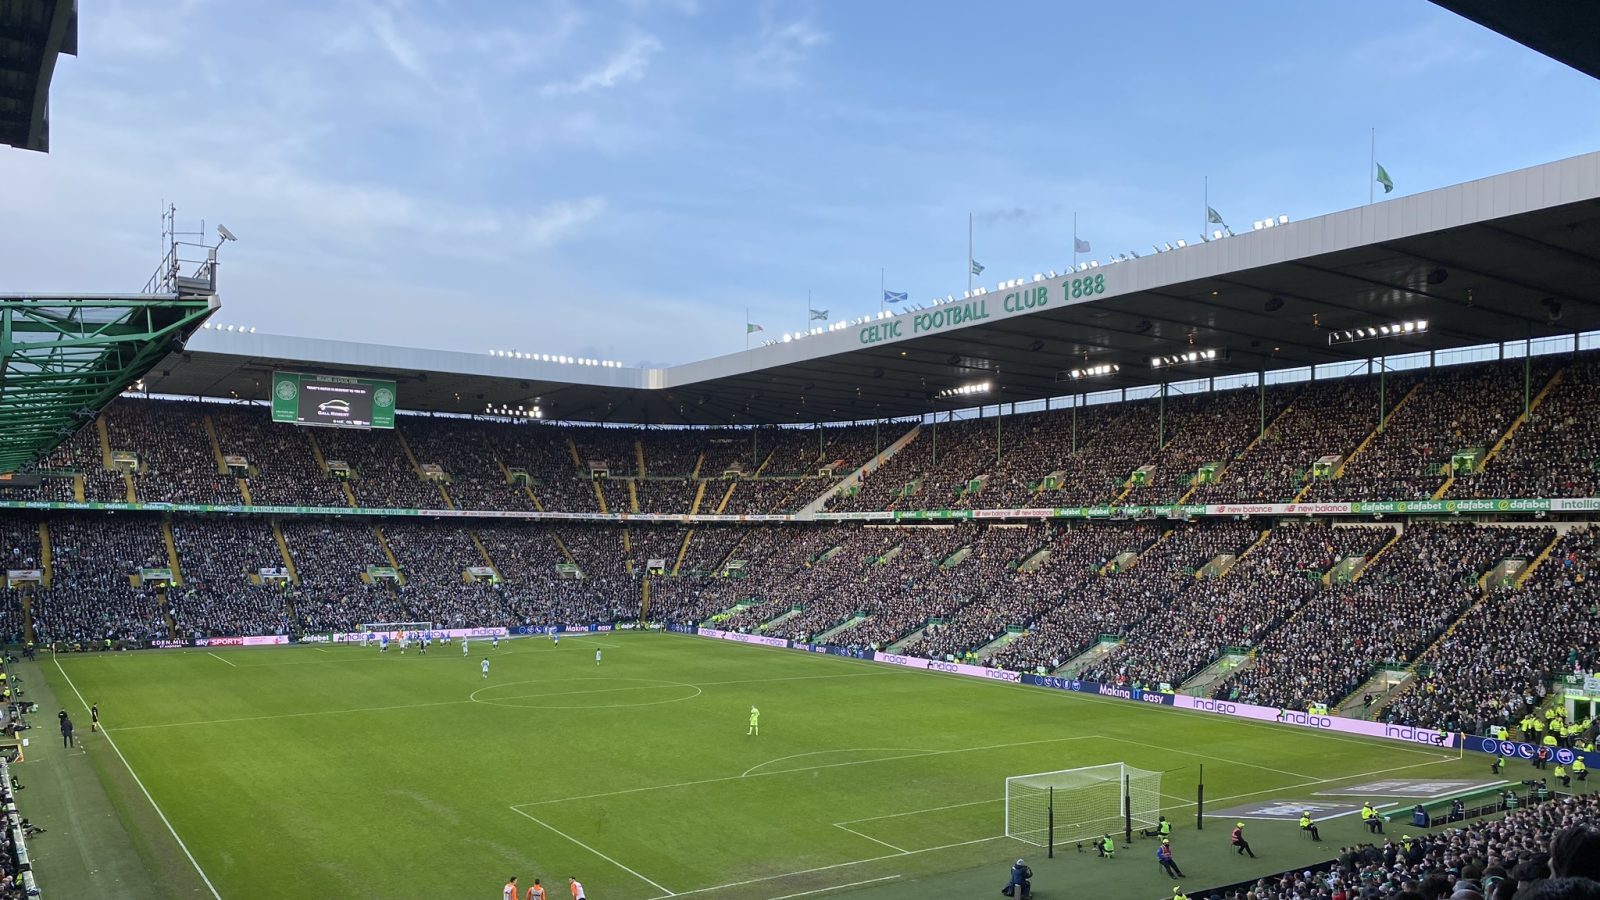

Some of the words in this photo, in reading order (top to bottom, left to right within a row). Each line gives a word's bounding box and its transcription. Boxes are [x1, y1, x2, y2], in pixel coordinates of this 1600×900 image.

[859, 320, 902, 345] CELTIC
[913, 300, 990, 334] FOOTBALL
[1003, 286, 1048, 314] CLUB
[1062, 273, 1106, 301] 1888
[1241, 504, 1273, 513] balance
[1314, 503, 1348, 512] balance
[1361, 502, 1394, 512] dafabet
[1407, 501, 1442, 511] dafabet
[1457, 500, 1494, 510] dafabet
[1510, 499, 1550, 509] dafabet
[1060, 508, 1080, 516] dafabet
[1088, 507, 1109, 515] dafabet
[566, 624, 589, 633] Making
[597, 624, 612, 633] easy
[195, 638, 209, 648] sky
[212, 637, 243, 646] SPORTS
[302, 633, 330, 642] dafabet
[1100, 684, 1131, 700] Making
[1132, 687, 1142, 700] IT
[1142, 692, 1164, 706] easy
[1193, 695, 1237, 715] indigo
